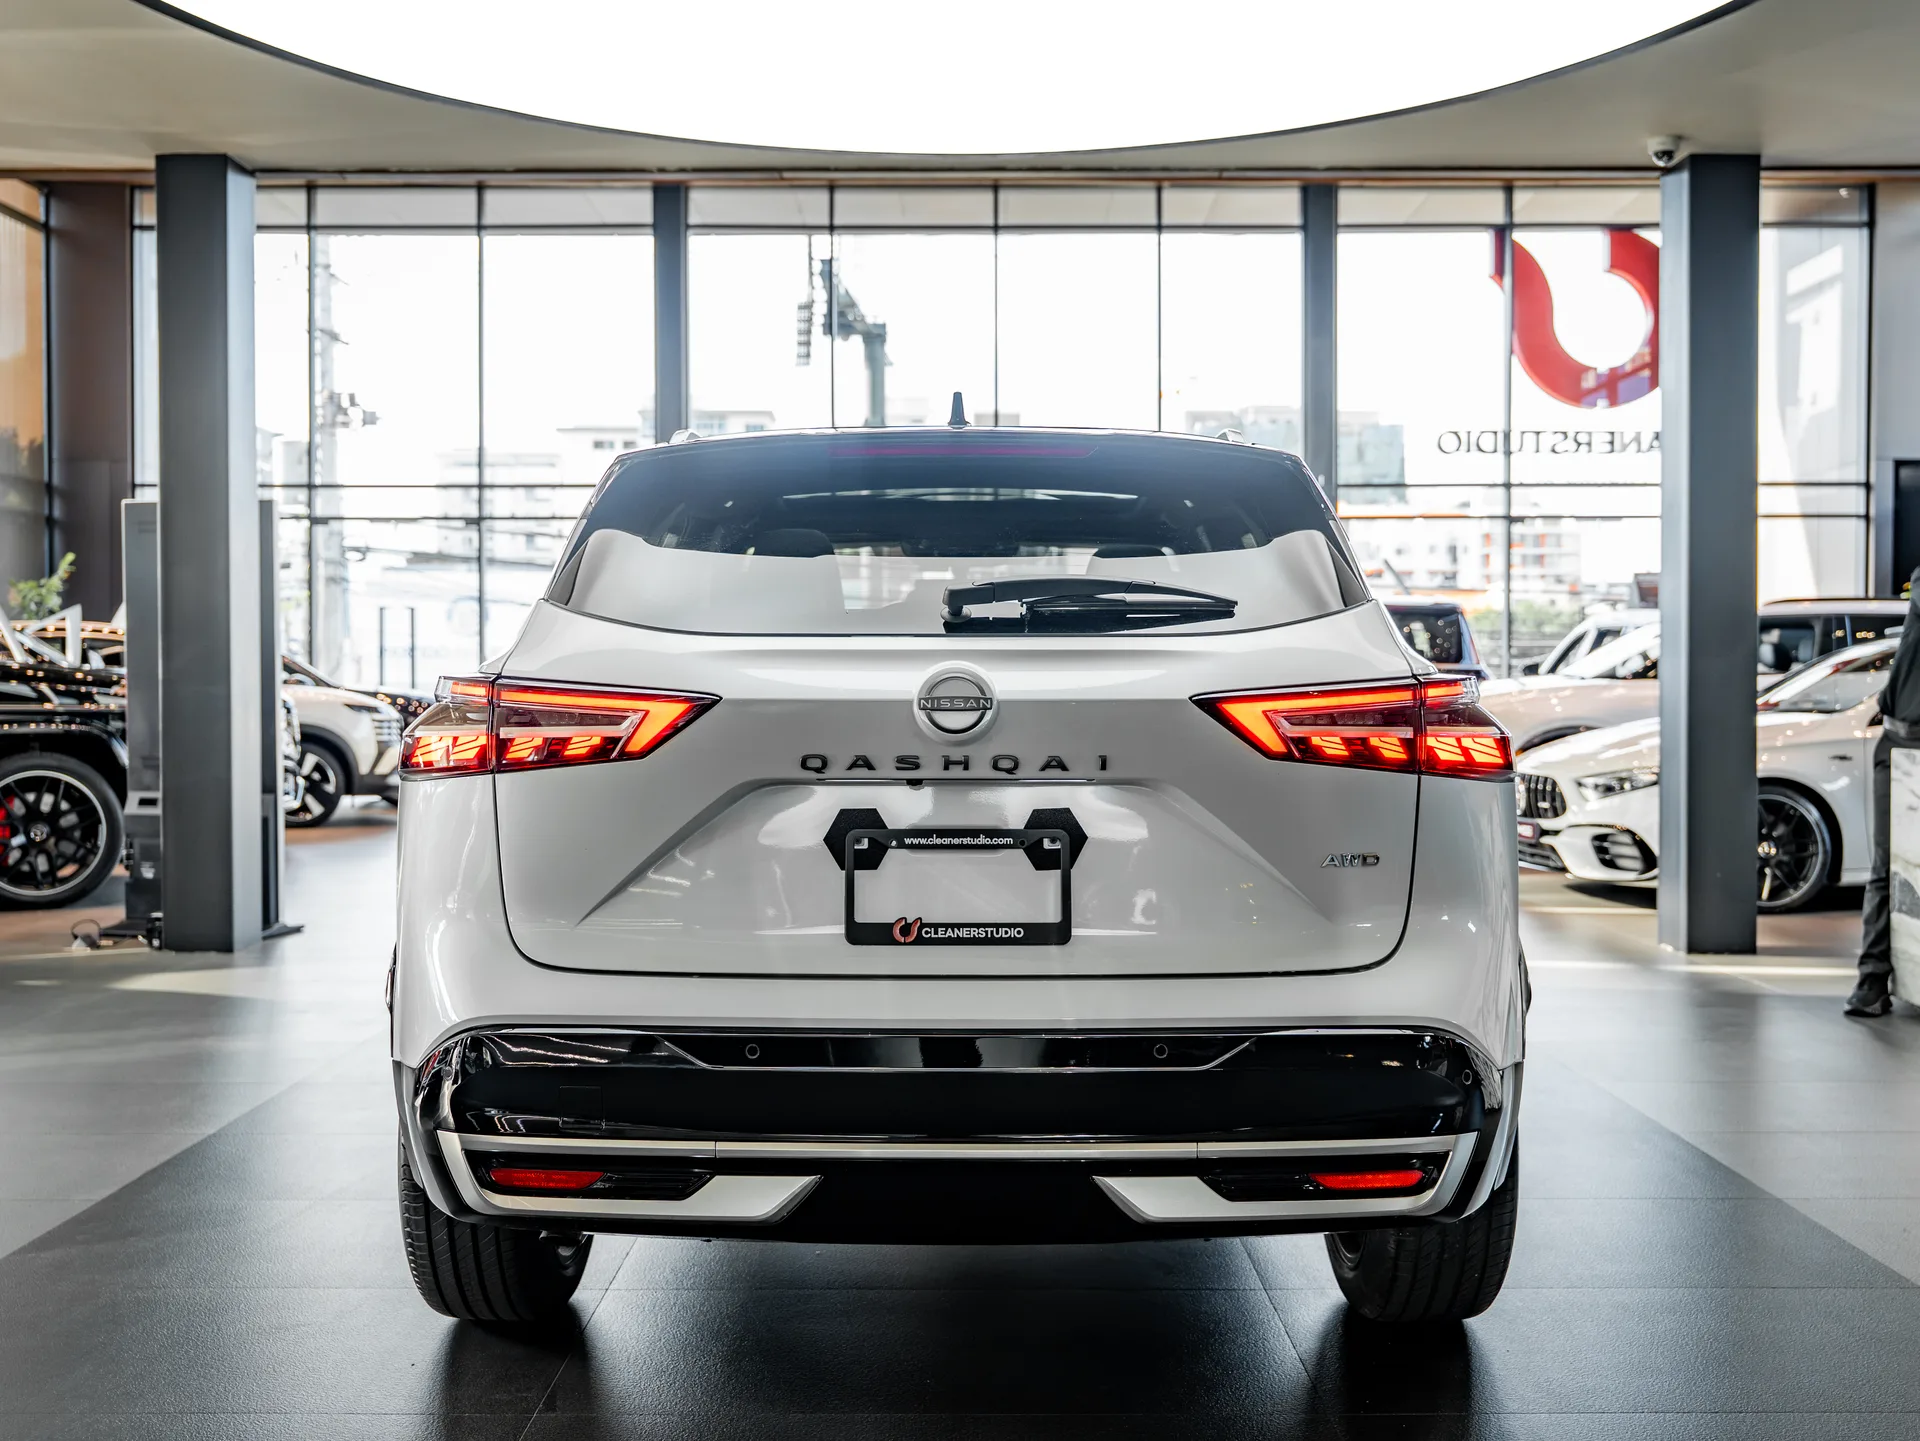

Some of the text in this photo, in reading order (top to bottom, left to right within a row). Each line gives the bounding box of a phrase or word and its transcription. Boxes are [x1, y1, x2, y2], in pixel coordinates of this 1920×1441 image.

[920, 698, 991, 708] NISSAN
[800, 754, 1108, 774] QASHQAI
[904, 834, 1013, 845] www.cleanerstudio.com
[1320, 853, 1380, 868] AWD
[921, 927, 1024, 938] CLEANERSTUDIO
